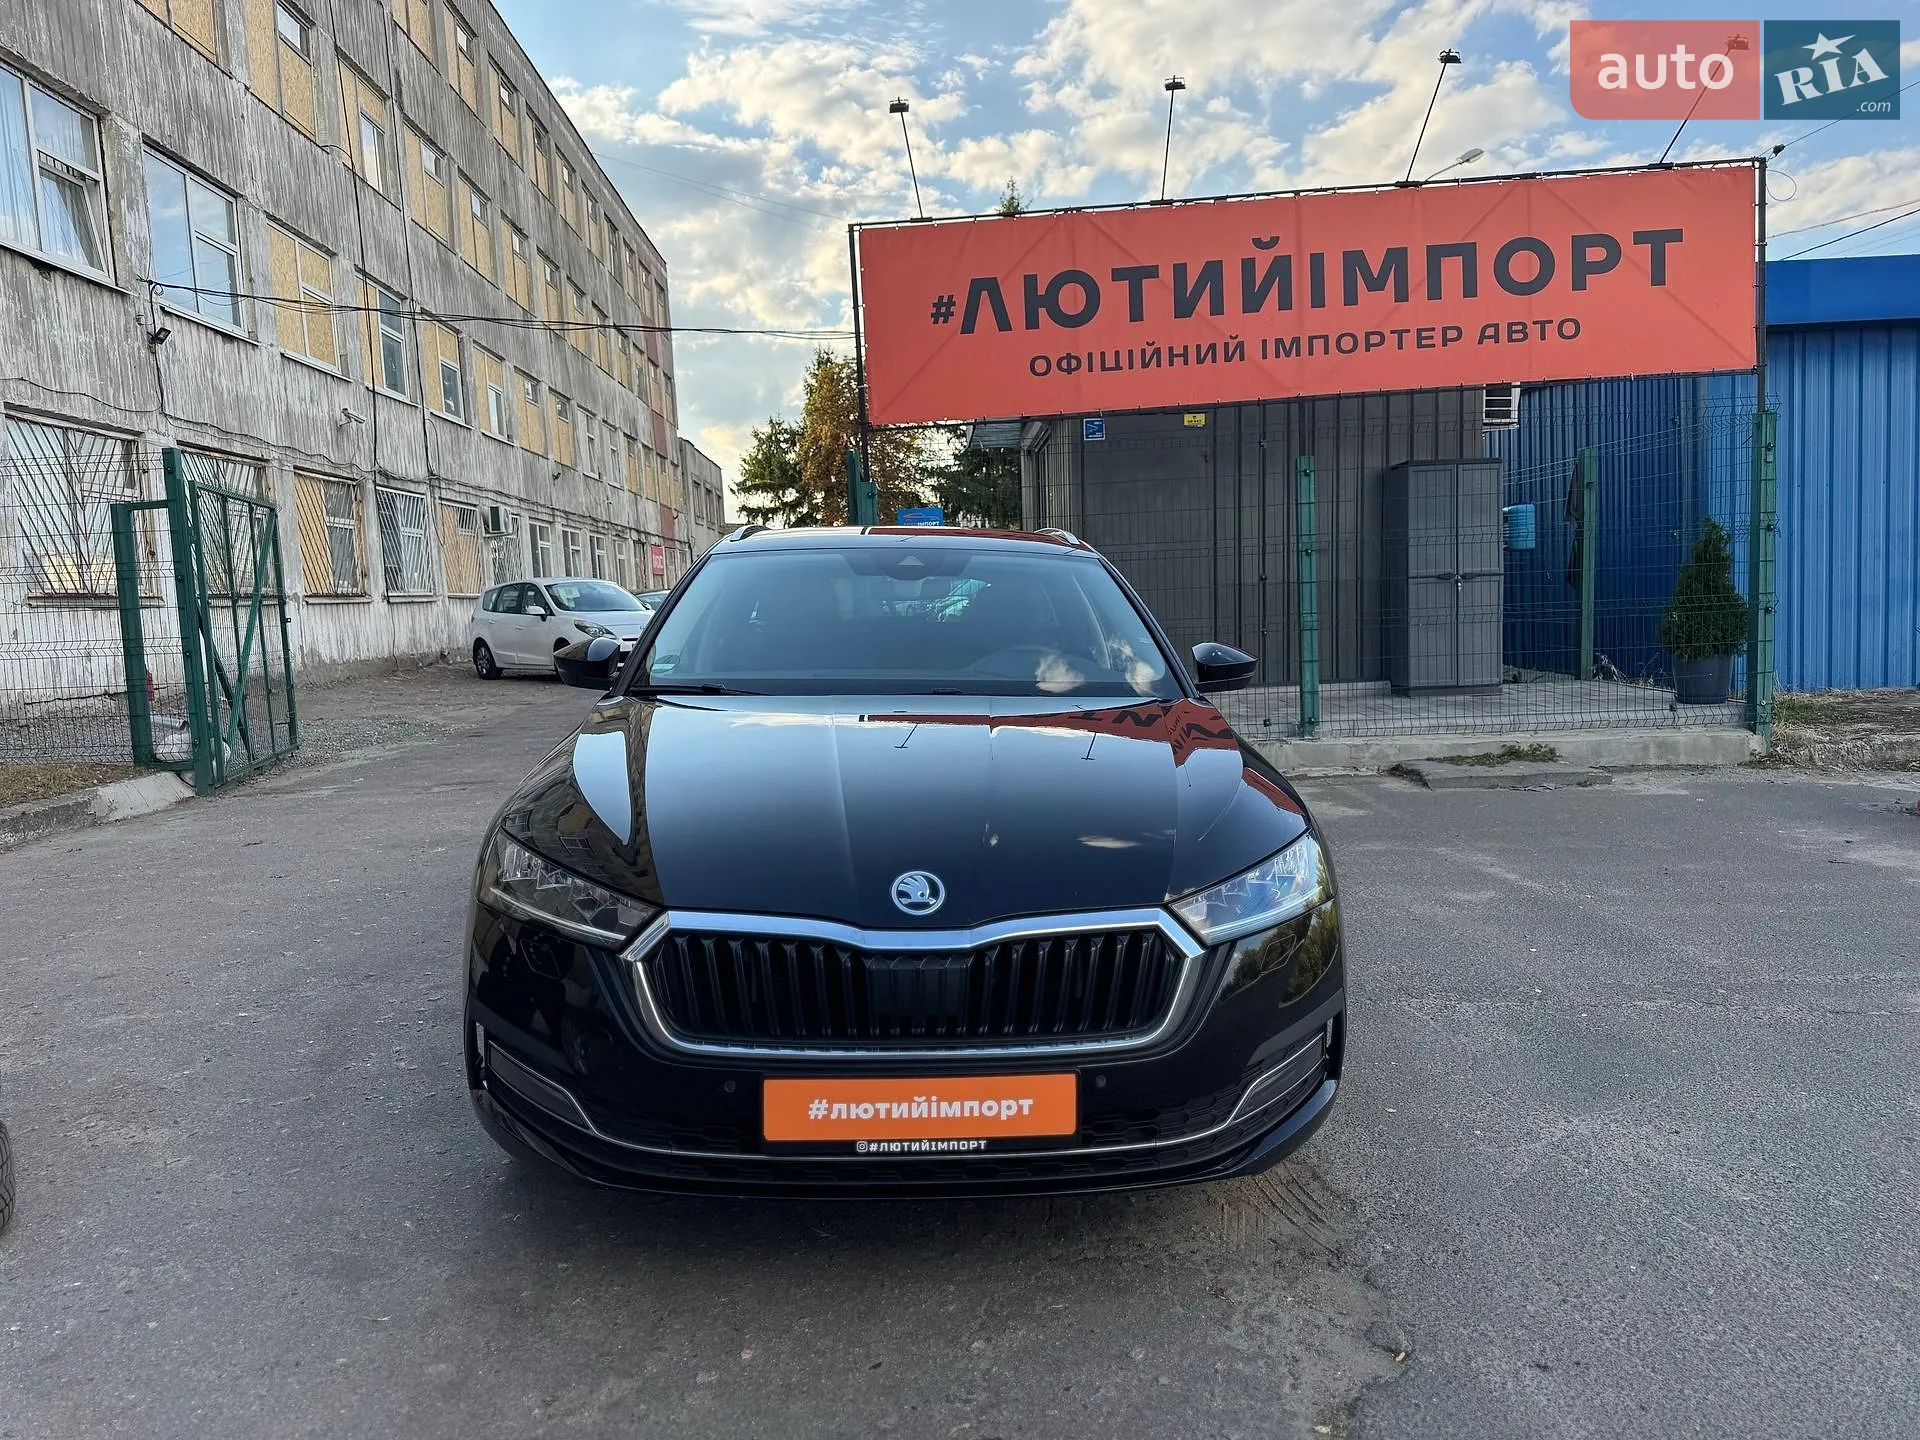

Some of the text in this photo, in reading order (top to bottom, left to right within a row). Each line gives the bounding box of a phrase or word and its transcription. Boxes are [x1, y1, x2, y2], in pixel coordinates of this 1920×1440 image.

[930, 228, 1684, 335] #ЛЮТИЙІМПОРТ
[1029, 317, 1581, 377] ОФІЦІЙНИЙ ІМПОРТЕР АВТО
[808, 1095, 1034, 1120] #лютийімпорт
[869, 1139, 987, 1152] #ЛЮТИЙІМПОРТ
